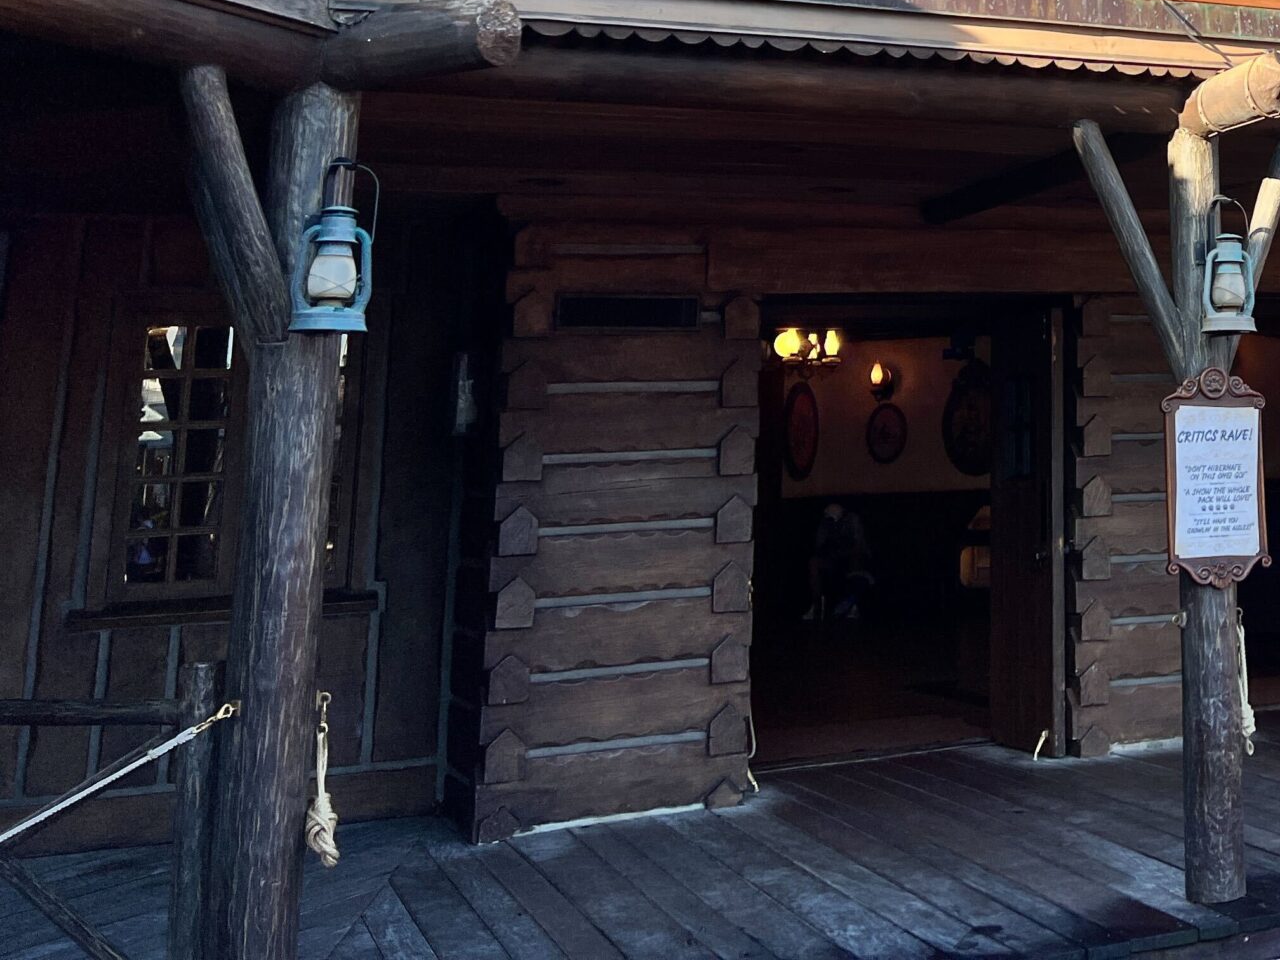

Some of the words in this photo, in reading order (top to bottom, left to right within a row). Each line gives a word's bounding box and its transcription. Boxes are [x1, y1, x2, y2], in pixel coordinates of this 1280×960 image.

[1177, 429, 1219, 443] CRITICS
[1220, 428, 1253, 441] RAVE!
[1202, 472, 1216, 480] THIS
[1191, 487, 1212, 496] SHOW
[1213, 487, 1226, 495] THE
